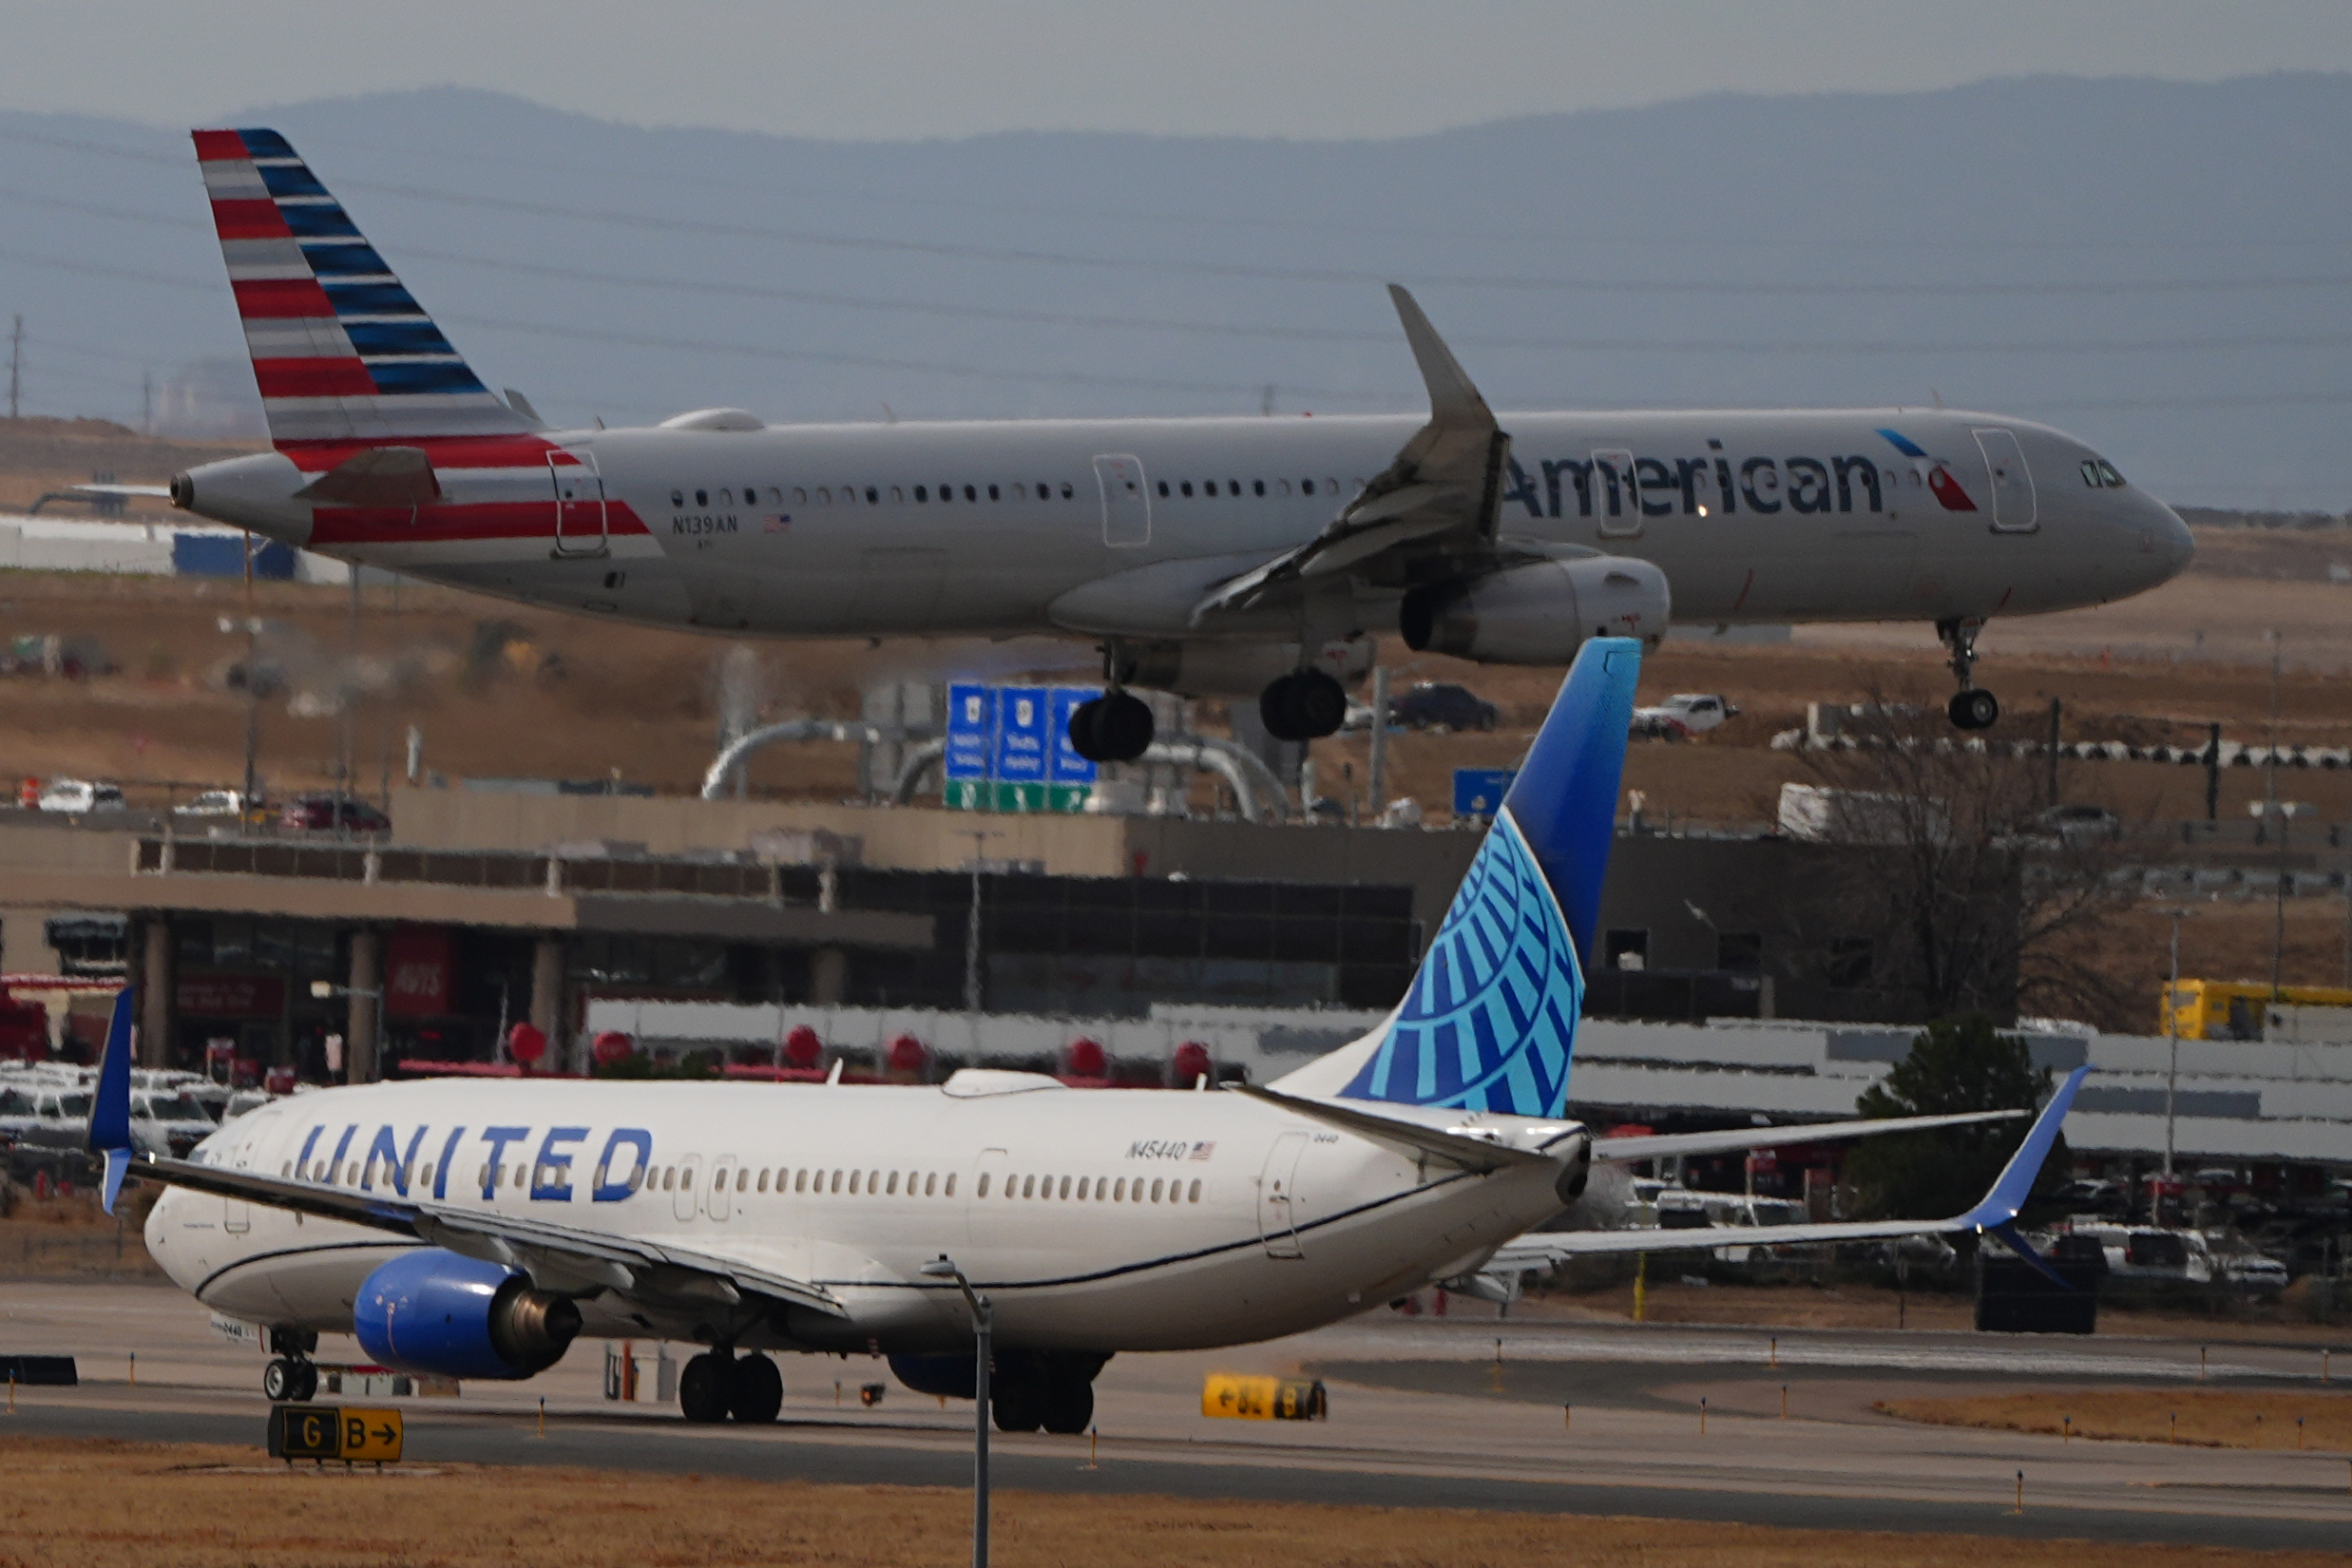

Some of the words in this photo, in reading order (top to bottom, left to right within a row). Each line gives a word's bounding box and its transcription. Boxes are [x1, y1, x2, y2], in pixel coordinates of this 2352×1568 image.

[672, 515, 738, 534] N139AN
[295, 1124, 653, 1202] UNITED
[1126, 1139, 1187, 1160] N45440
[303, 1415, 322, 1447] G
[347, 1418, 366, 1448] B
